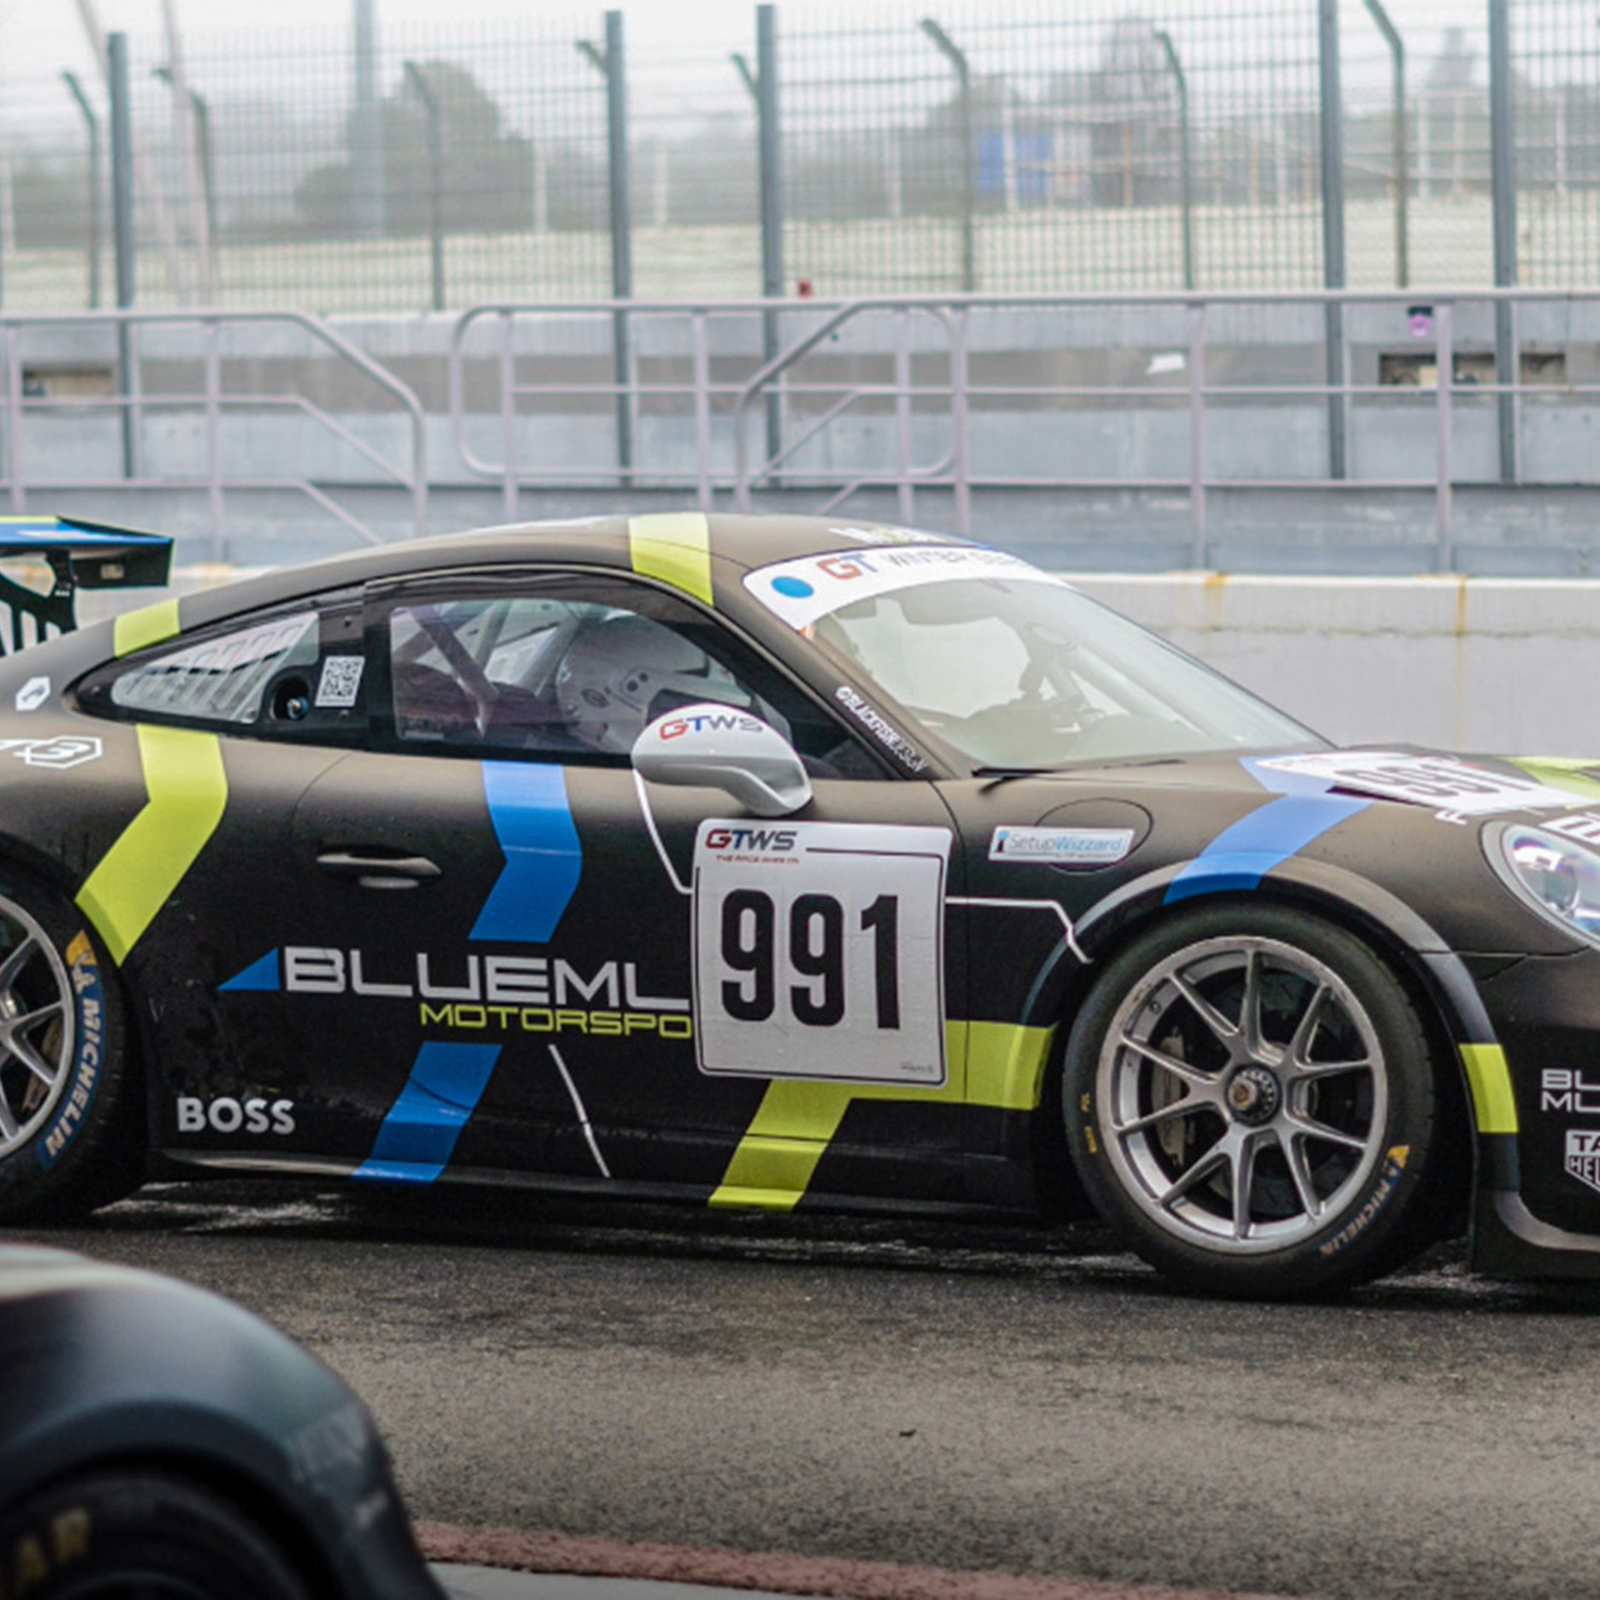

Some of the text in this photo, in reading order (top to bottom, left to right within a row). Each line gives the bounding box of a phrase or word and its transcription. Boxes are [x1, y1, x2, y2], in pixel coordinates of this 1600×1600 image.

[816, 552, 879, 580] GT
[659, 715, 764, 740] GTWS
[705, 829, 798, 851] GTWS
[721, 888, 900, 1031] 991
[45, 997, 101, 1156] MICHELIN
[178, 1097, 296, 1135] BOSS
